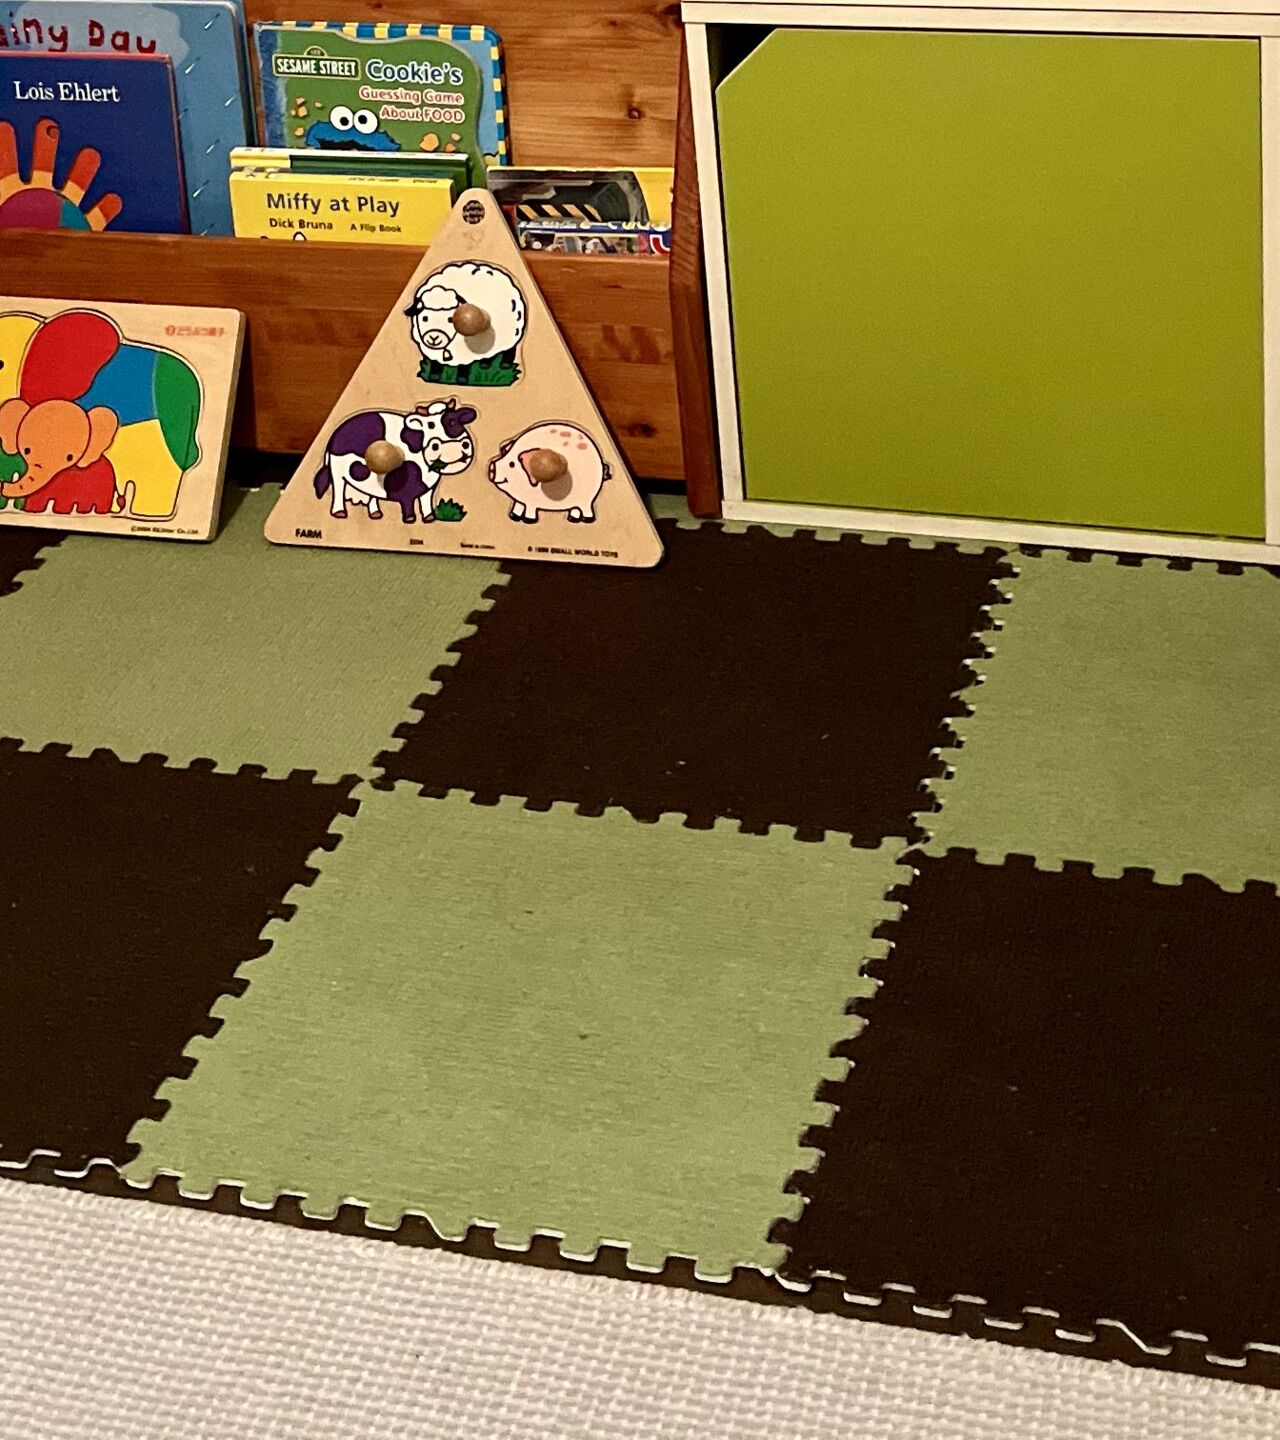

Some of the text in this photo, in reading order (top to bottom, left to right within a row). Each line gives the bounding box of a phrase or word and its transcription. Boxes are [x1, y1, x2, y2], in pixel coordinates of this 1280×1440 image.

[276, 58, 357, 76] SESAME STREET
[366, 59, 463, 85] Cookie's
[13, 80, 121, 103] Lois Ehlert
[359, 86, 464, 105] Guessing Game
[380, 105, 465, 123] About FOOD
[266, 192, 400, 217] Miffy at Play
[269, 217, 295, 229] Dick
[298, 219, 333, 231] Bruna
[350, 223, 358, 232] A
[379, 224, 402, 233] Book
[295, 528, 322, 539] FARM
